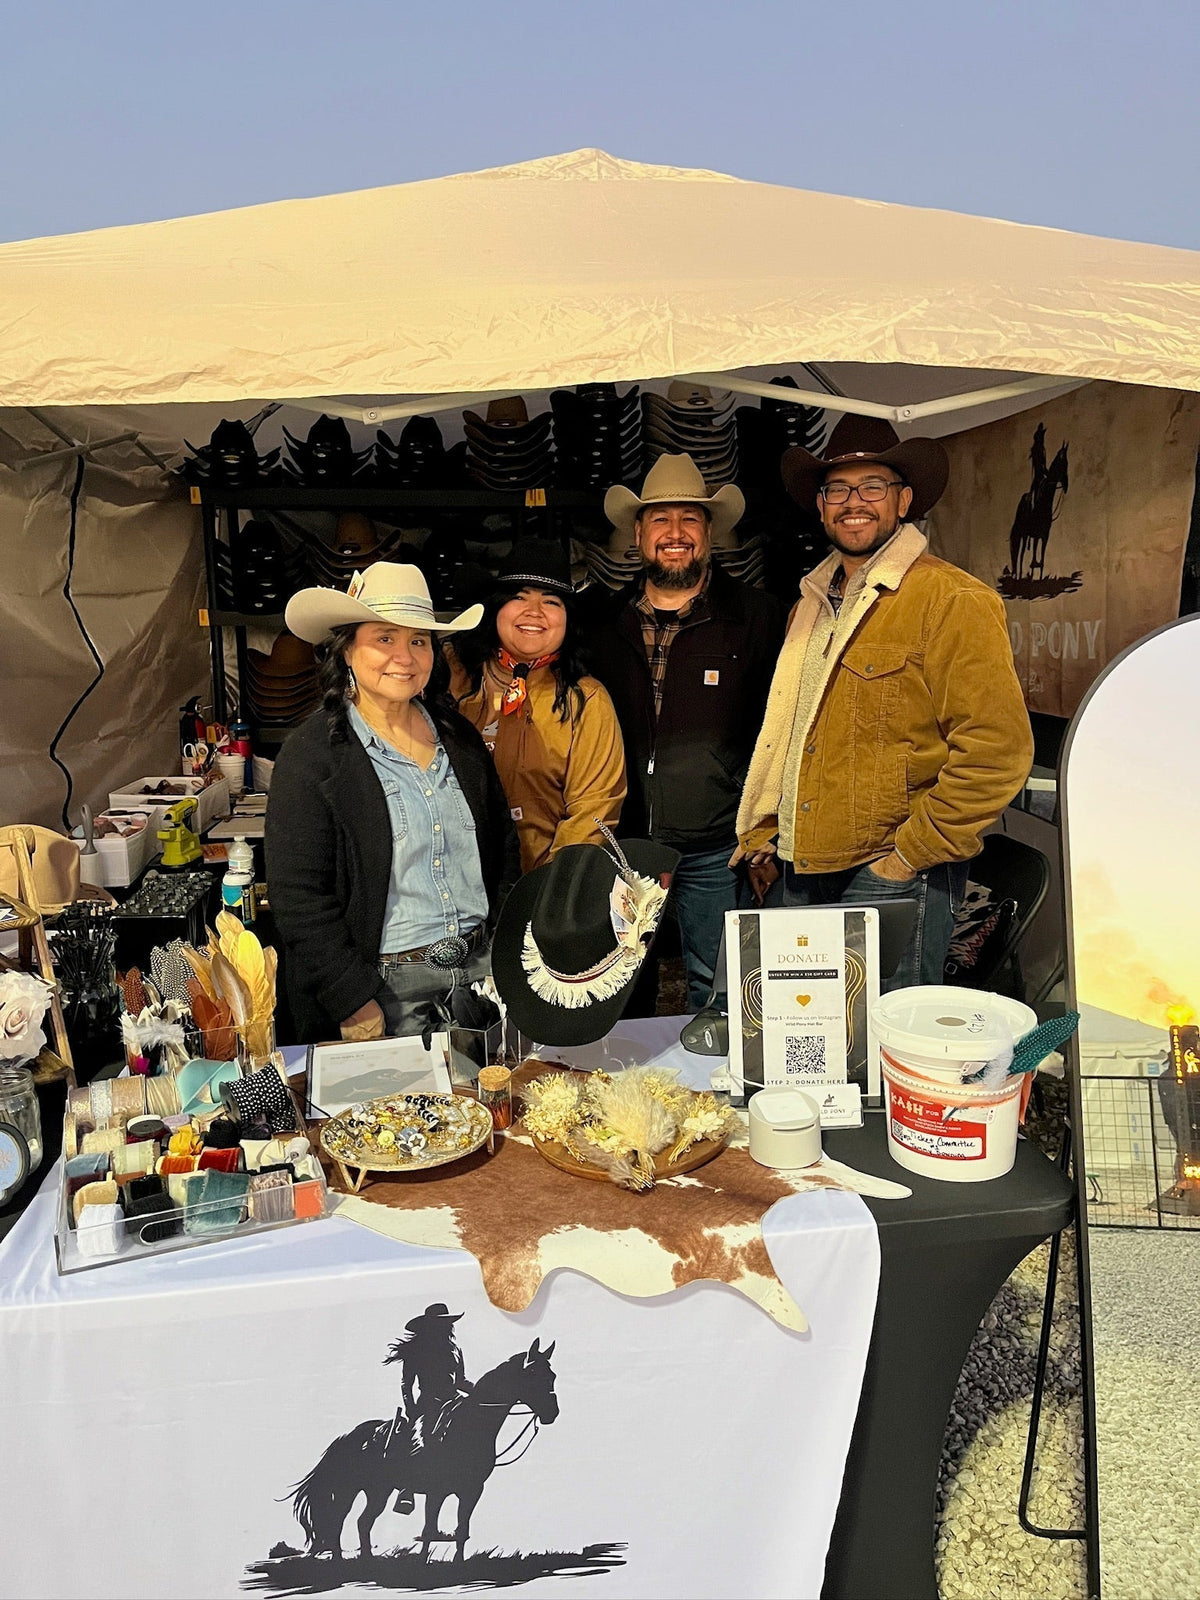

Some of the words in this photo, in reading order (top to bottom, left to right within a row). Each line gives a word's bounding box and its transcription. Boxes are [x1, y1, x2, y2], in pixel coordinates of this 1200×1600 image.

[1010, 621, 1023, 656] D
[1031, 620, 1101, 660] PONY
[777, 953, 829, 963] DONATE
[925, 1109, 940, 1117] FOR
[936, 1137, 976, 1148] Committee
